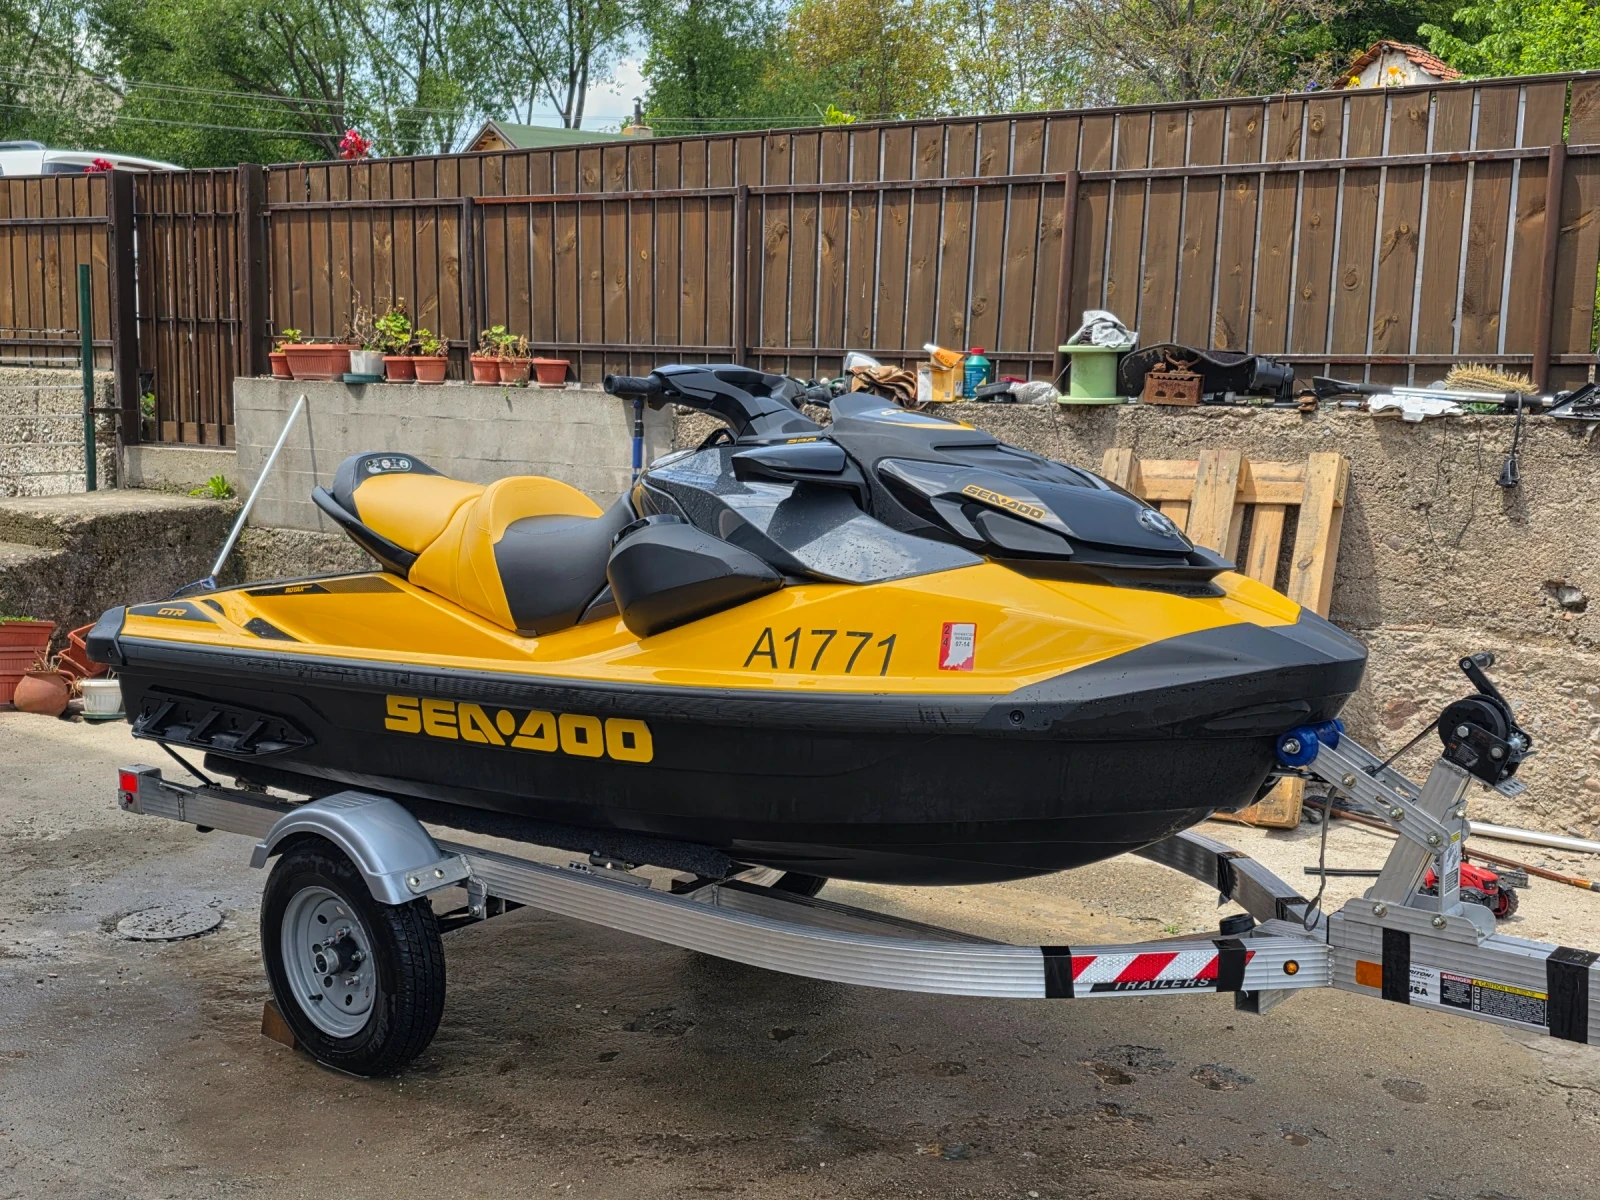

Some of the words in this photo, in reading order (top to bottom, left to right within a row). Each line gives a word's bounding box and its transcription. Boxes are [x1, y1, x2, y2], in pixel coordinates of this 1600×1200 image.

[157, 607, 187, 617] GTR
[944, 624, 950, 634] 2
[943, 638, 948, 646] 4
[743, 627, 897, 676] A1771
[1113, 977, 1210, 991] TRAILERS
[1447, 974, 1472, 984] DANGER
[1480, 981, 1506, 992] CAUTION
